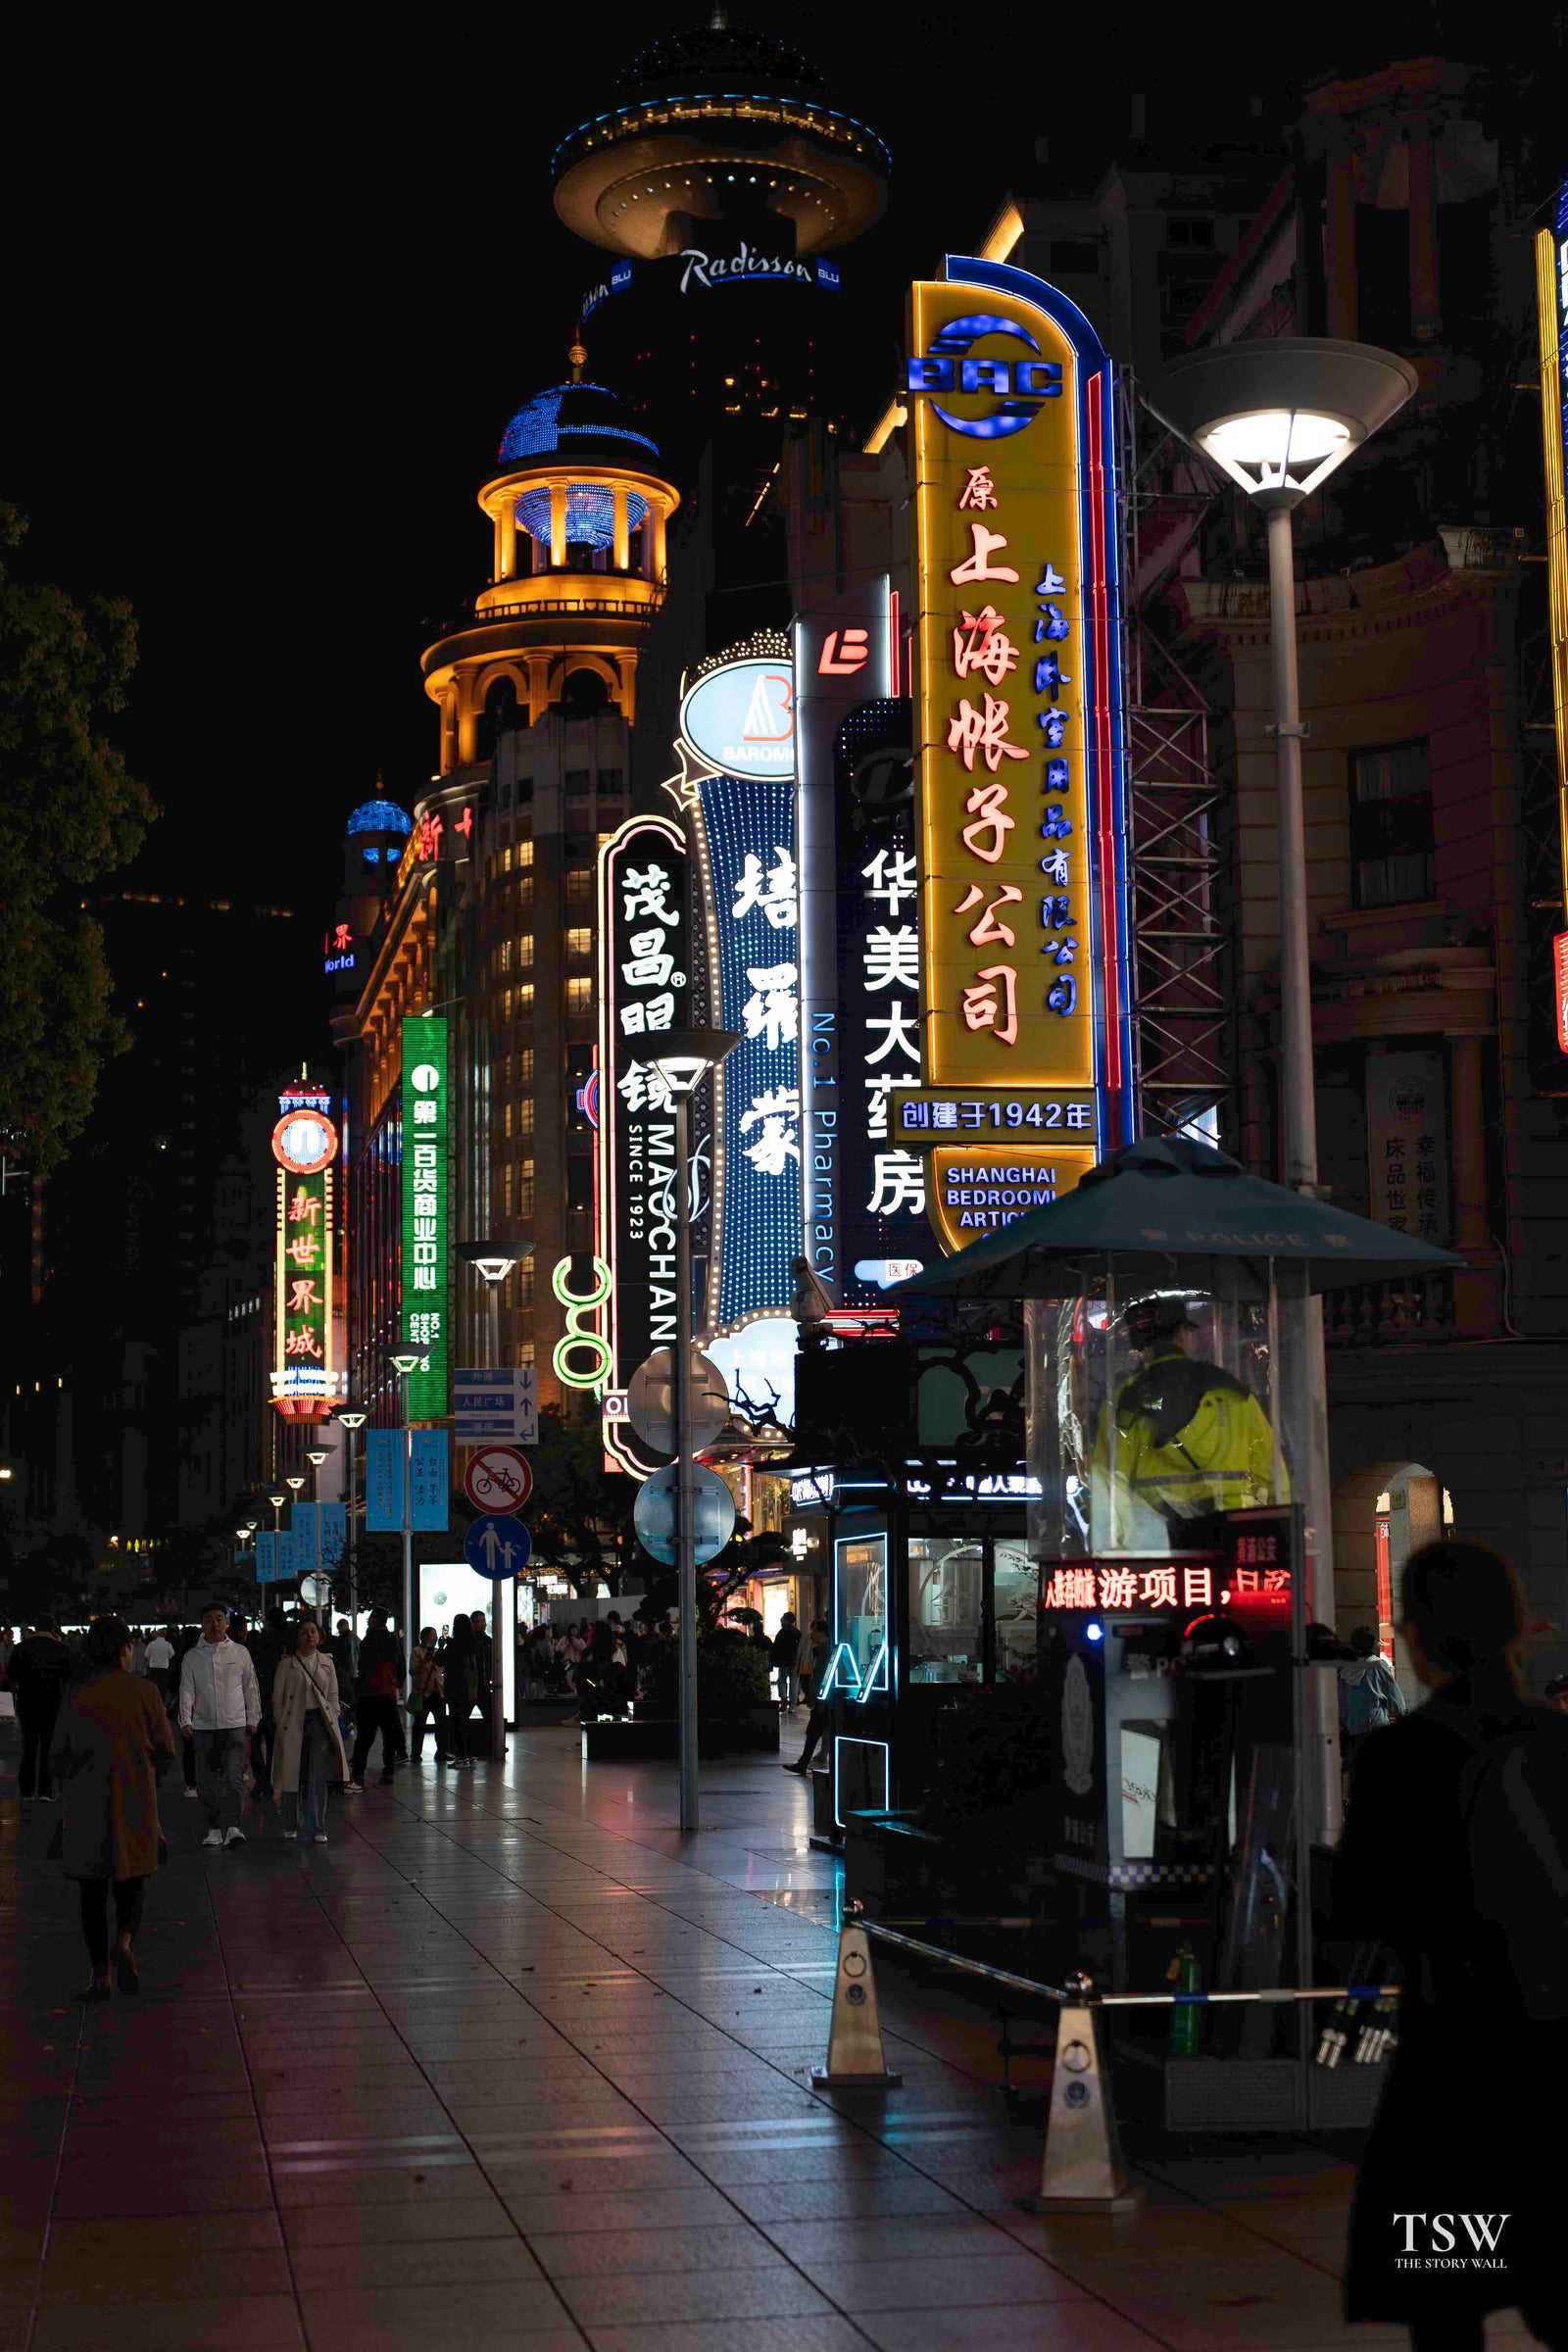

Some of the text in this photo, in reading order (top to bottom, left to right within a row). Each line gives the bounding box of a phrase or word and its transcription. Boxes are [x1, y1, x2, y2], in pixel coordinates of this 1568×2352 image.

[612, 270, 631, 285] BLU
[680, 242, 840, 293] Radisson BLU
[907, 357, 1063, 397] BAC
[902, 1101, 1093, 1130] 创建于1942年
[412, 1100, 437, 1290] 第一百货商业中心
[629, 1125, 644, 1240] SINCE 1923
[811, 1110, 838, 1285] Pharmacy
[947, 1167, 1056, 1184] SHANGHAI
[648, 1124, 677, 1356] MAOCHAN
[285, 1196, 323, 1359] 新世界城
[888, 1263, 919, 1279] 医保
[430, 1312, 440, 1339] NO.1
